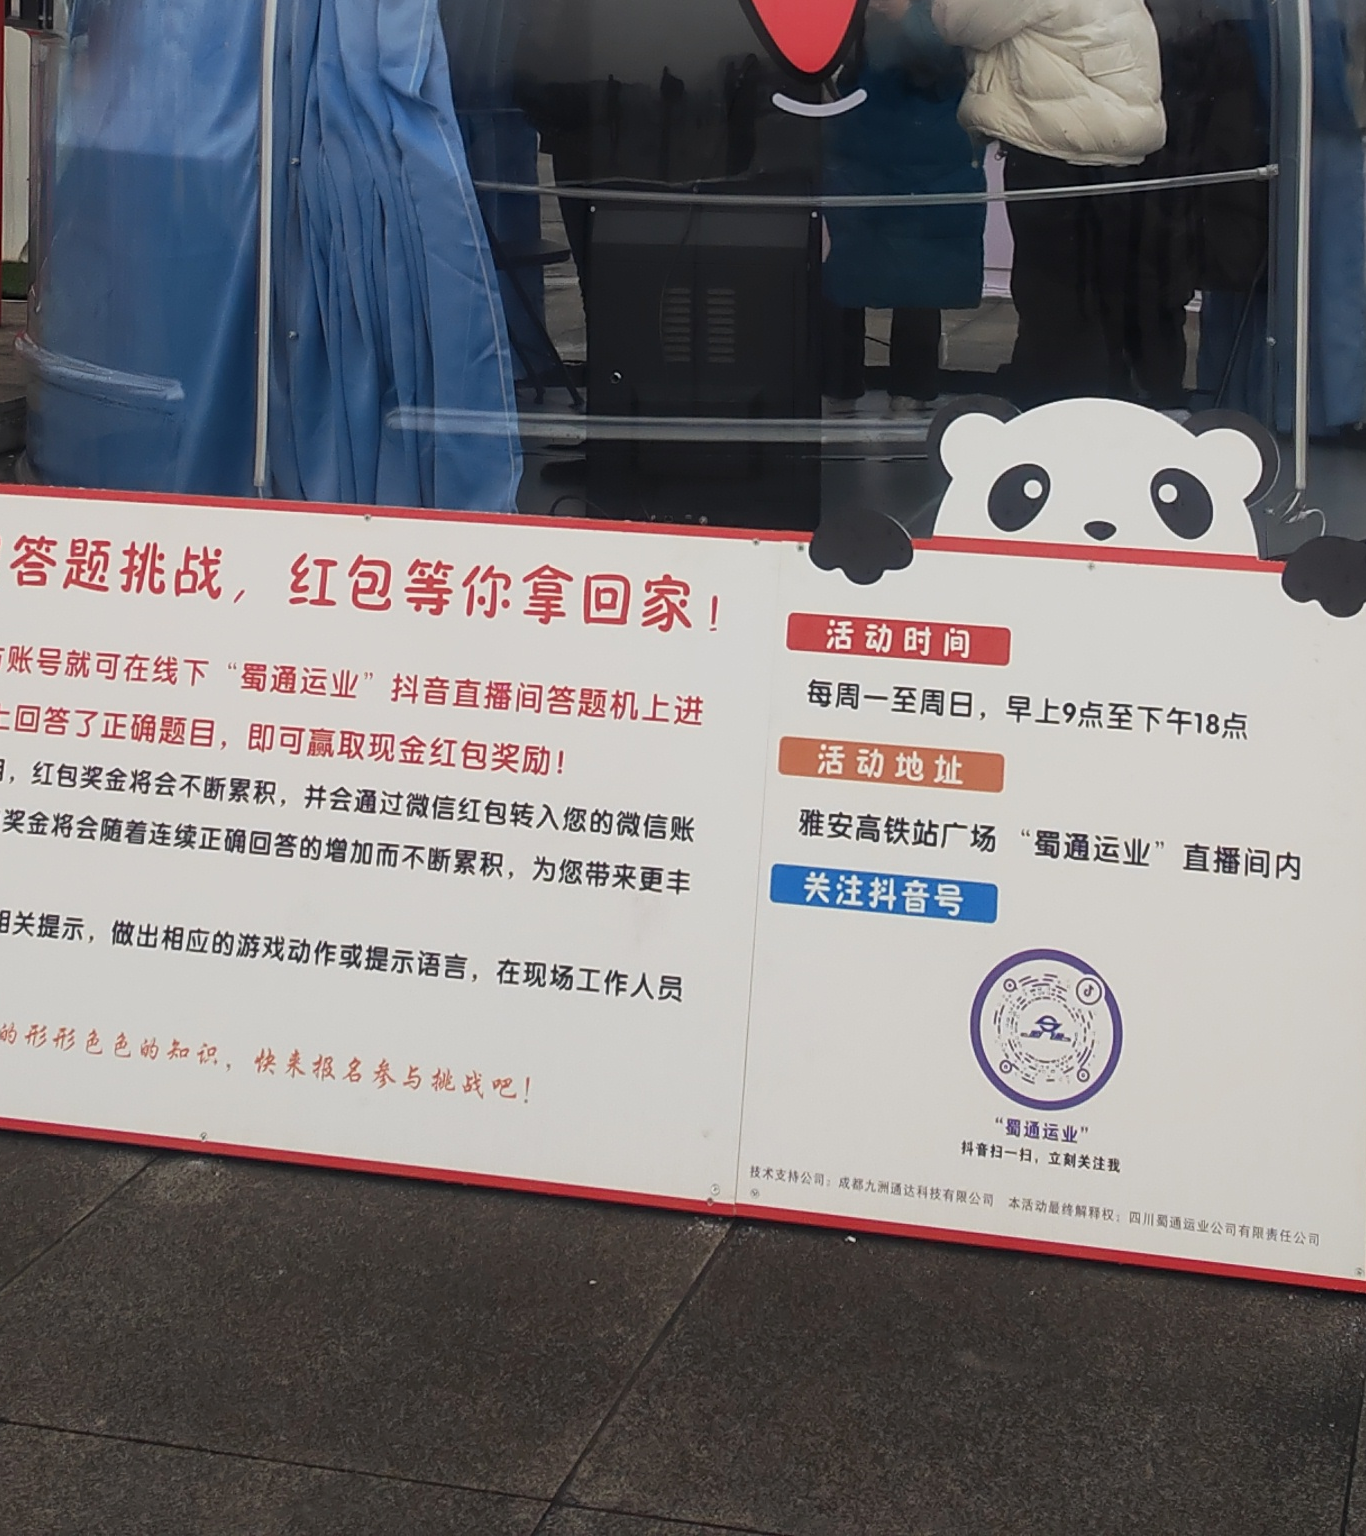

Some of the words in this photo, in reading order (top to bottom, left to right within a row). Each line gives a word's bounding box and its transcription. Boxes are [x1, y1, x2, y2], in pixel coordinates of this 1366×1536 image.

[826, 619, 972, 659] 活动时间
[816, 743, 964, 786] 活动地址
[803, 871, 964, 917] 关注抖音号
[995, 1116, 1089, 1144] “蜀通运业”
